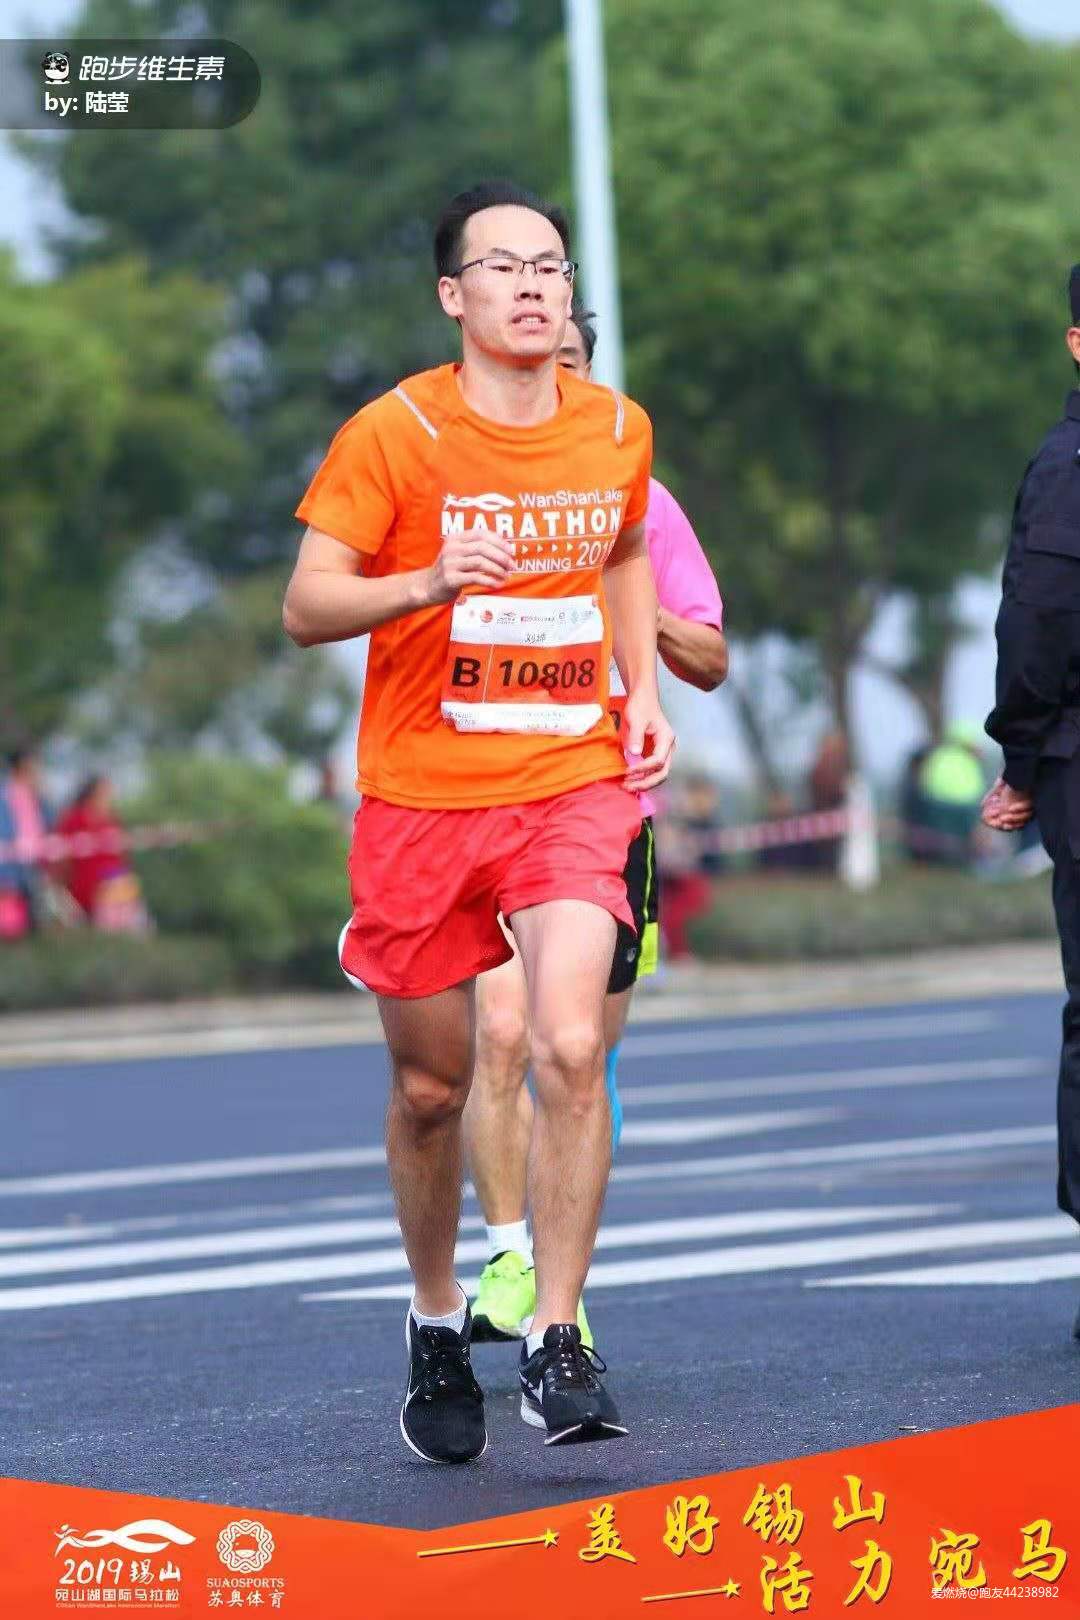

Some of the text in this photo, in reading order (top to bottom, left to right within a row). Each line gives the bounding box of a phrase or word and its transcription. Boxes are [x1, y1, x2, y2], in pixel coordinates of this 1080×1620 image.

[518, 487, 624, 509] WanShanLake
[441, 506, 622, 538] MARATHON
[514, 557, 572, 571] UNNING
[451, 656, 596, 690] B 10808
